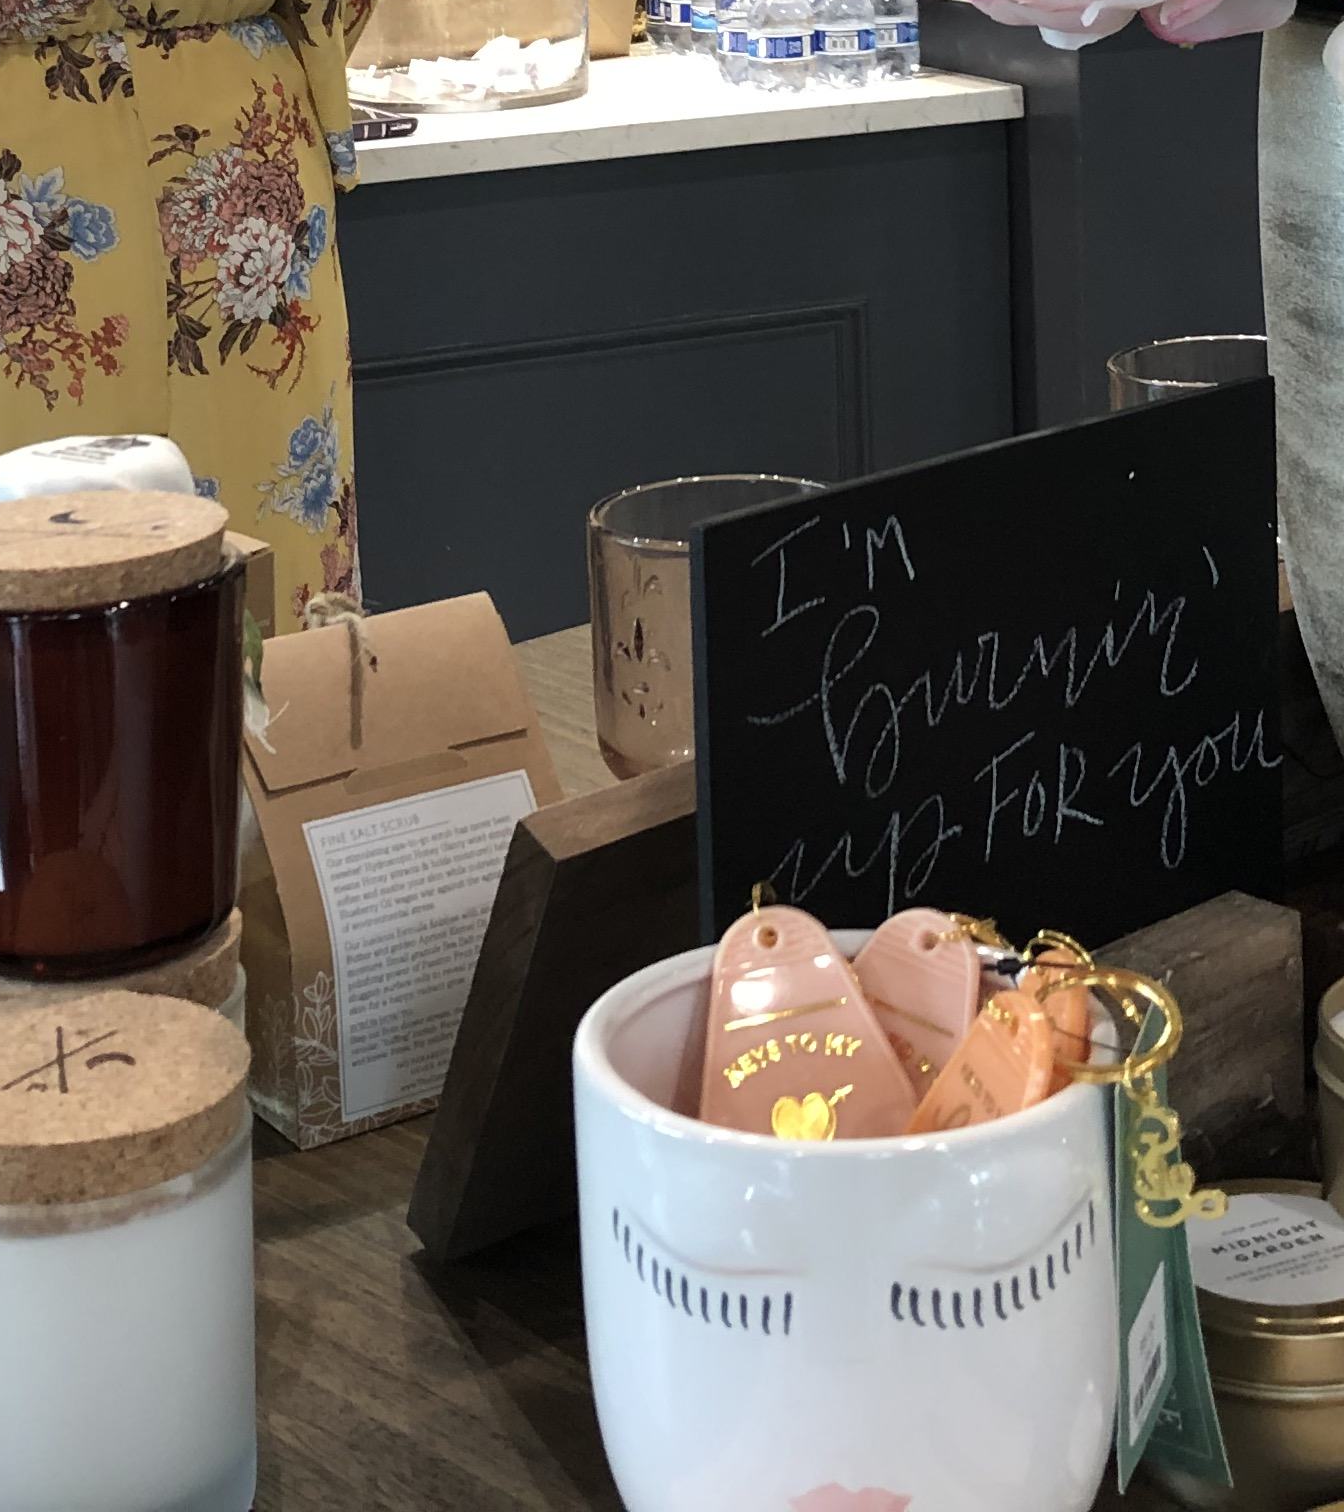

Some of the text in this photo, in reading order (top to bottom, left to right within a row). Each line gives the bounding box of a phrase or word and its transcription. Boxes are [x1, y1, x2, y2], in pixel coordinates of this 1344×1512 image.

[752, 516, 914, 636] I'M
[350, 824, 378, 839] SALT
[381, 813, 421, 834] SCRUB
[767, 794, 962, 918] up
[1108, 709, 1283, 869] you
[723, 1032, 863, 1089] KEYS TO MY
[1211, 1219, 1319, 1256] MIDNIGHT
[1234, 1233, 1325, 1263] GARDEN
